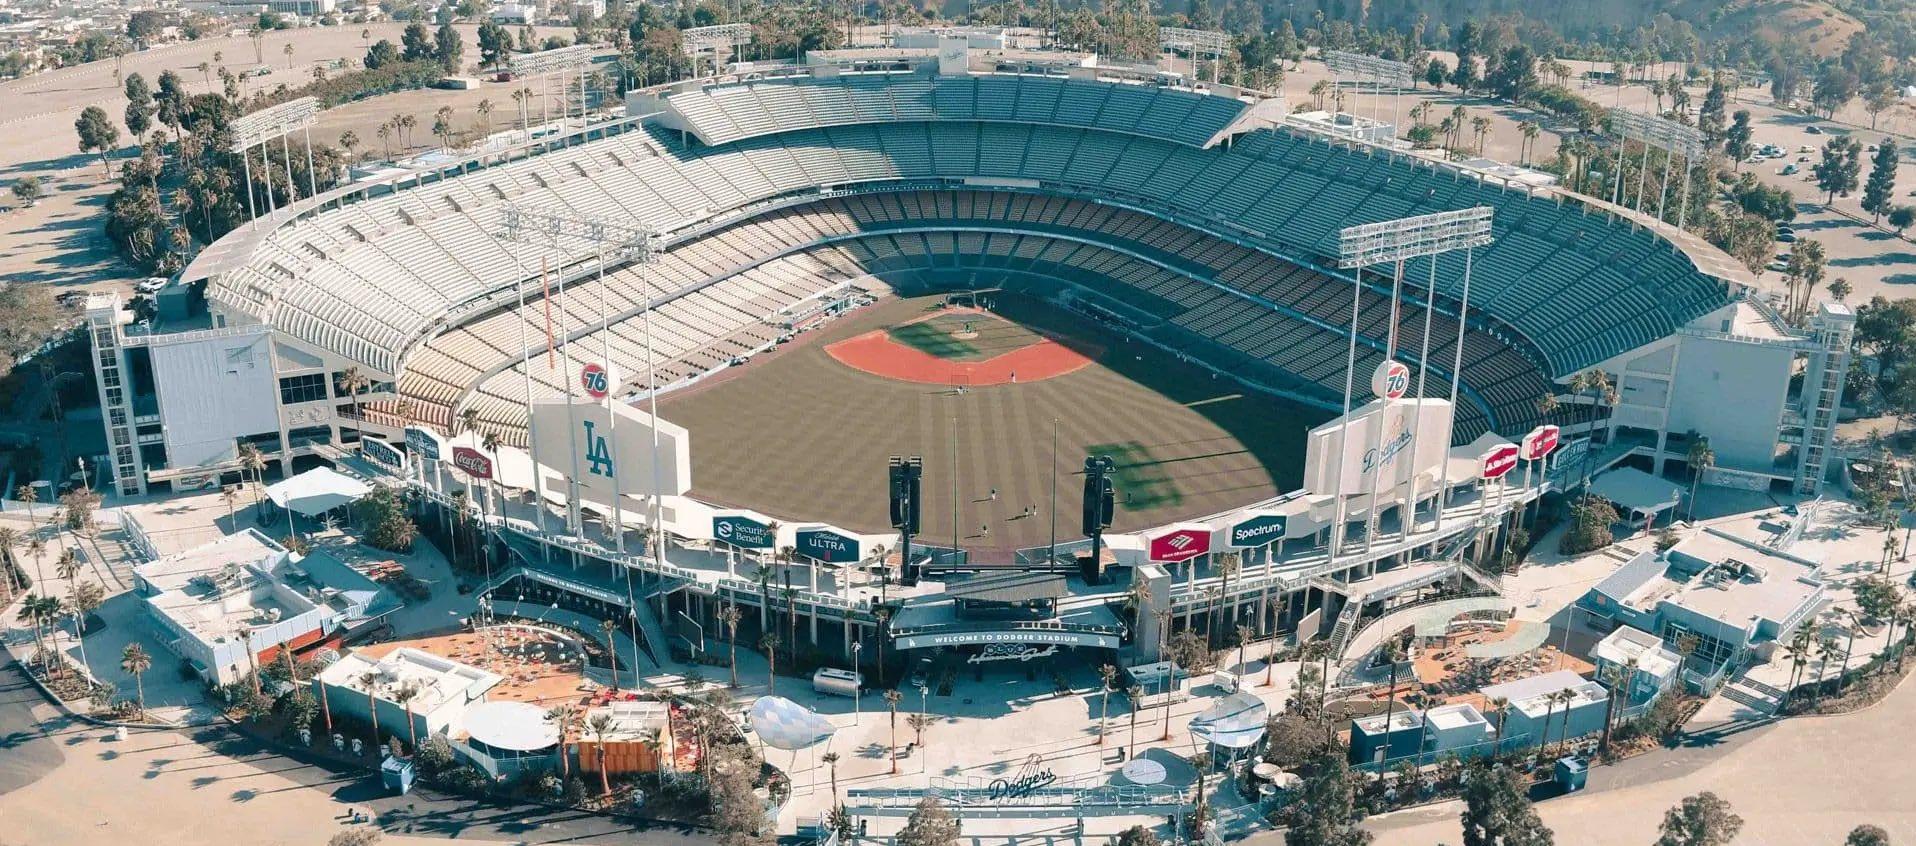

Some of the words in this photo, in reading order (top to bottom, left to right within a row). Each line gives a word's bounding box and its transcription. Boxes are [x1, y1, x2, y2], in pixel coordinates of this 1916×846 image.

[586, 371, 608, 391] 76
[1388, 371, 1405, 392] 76
[584, 420, 613, 477] LA
[735, 523, 769, 537] Security
[736, 532, 763, 544] Benefit
[1236, 523, 1281, 540] Spectrum
[809, 538, 846, 551] ULTRA
[935, 635, 977, 643] WELCOME
[988, 767, 1057, 800] Dodgers
